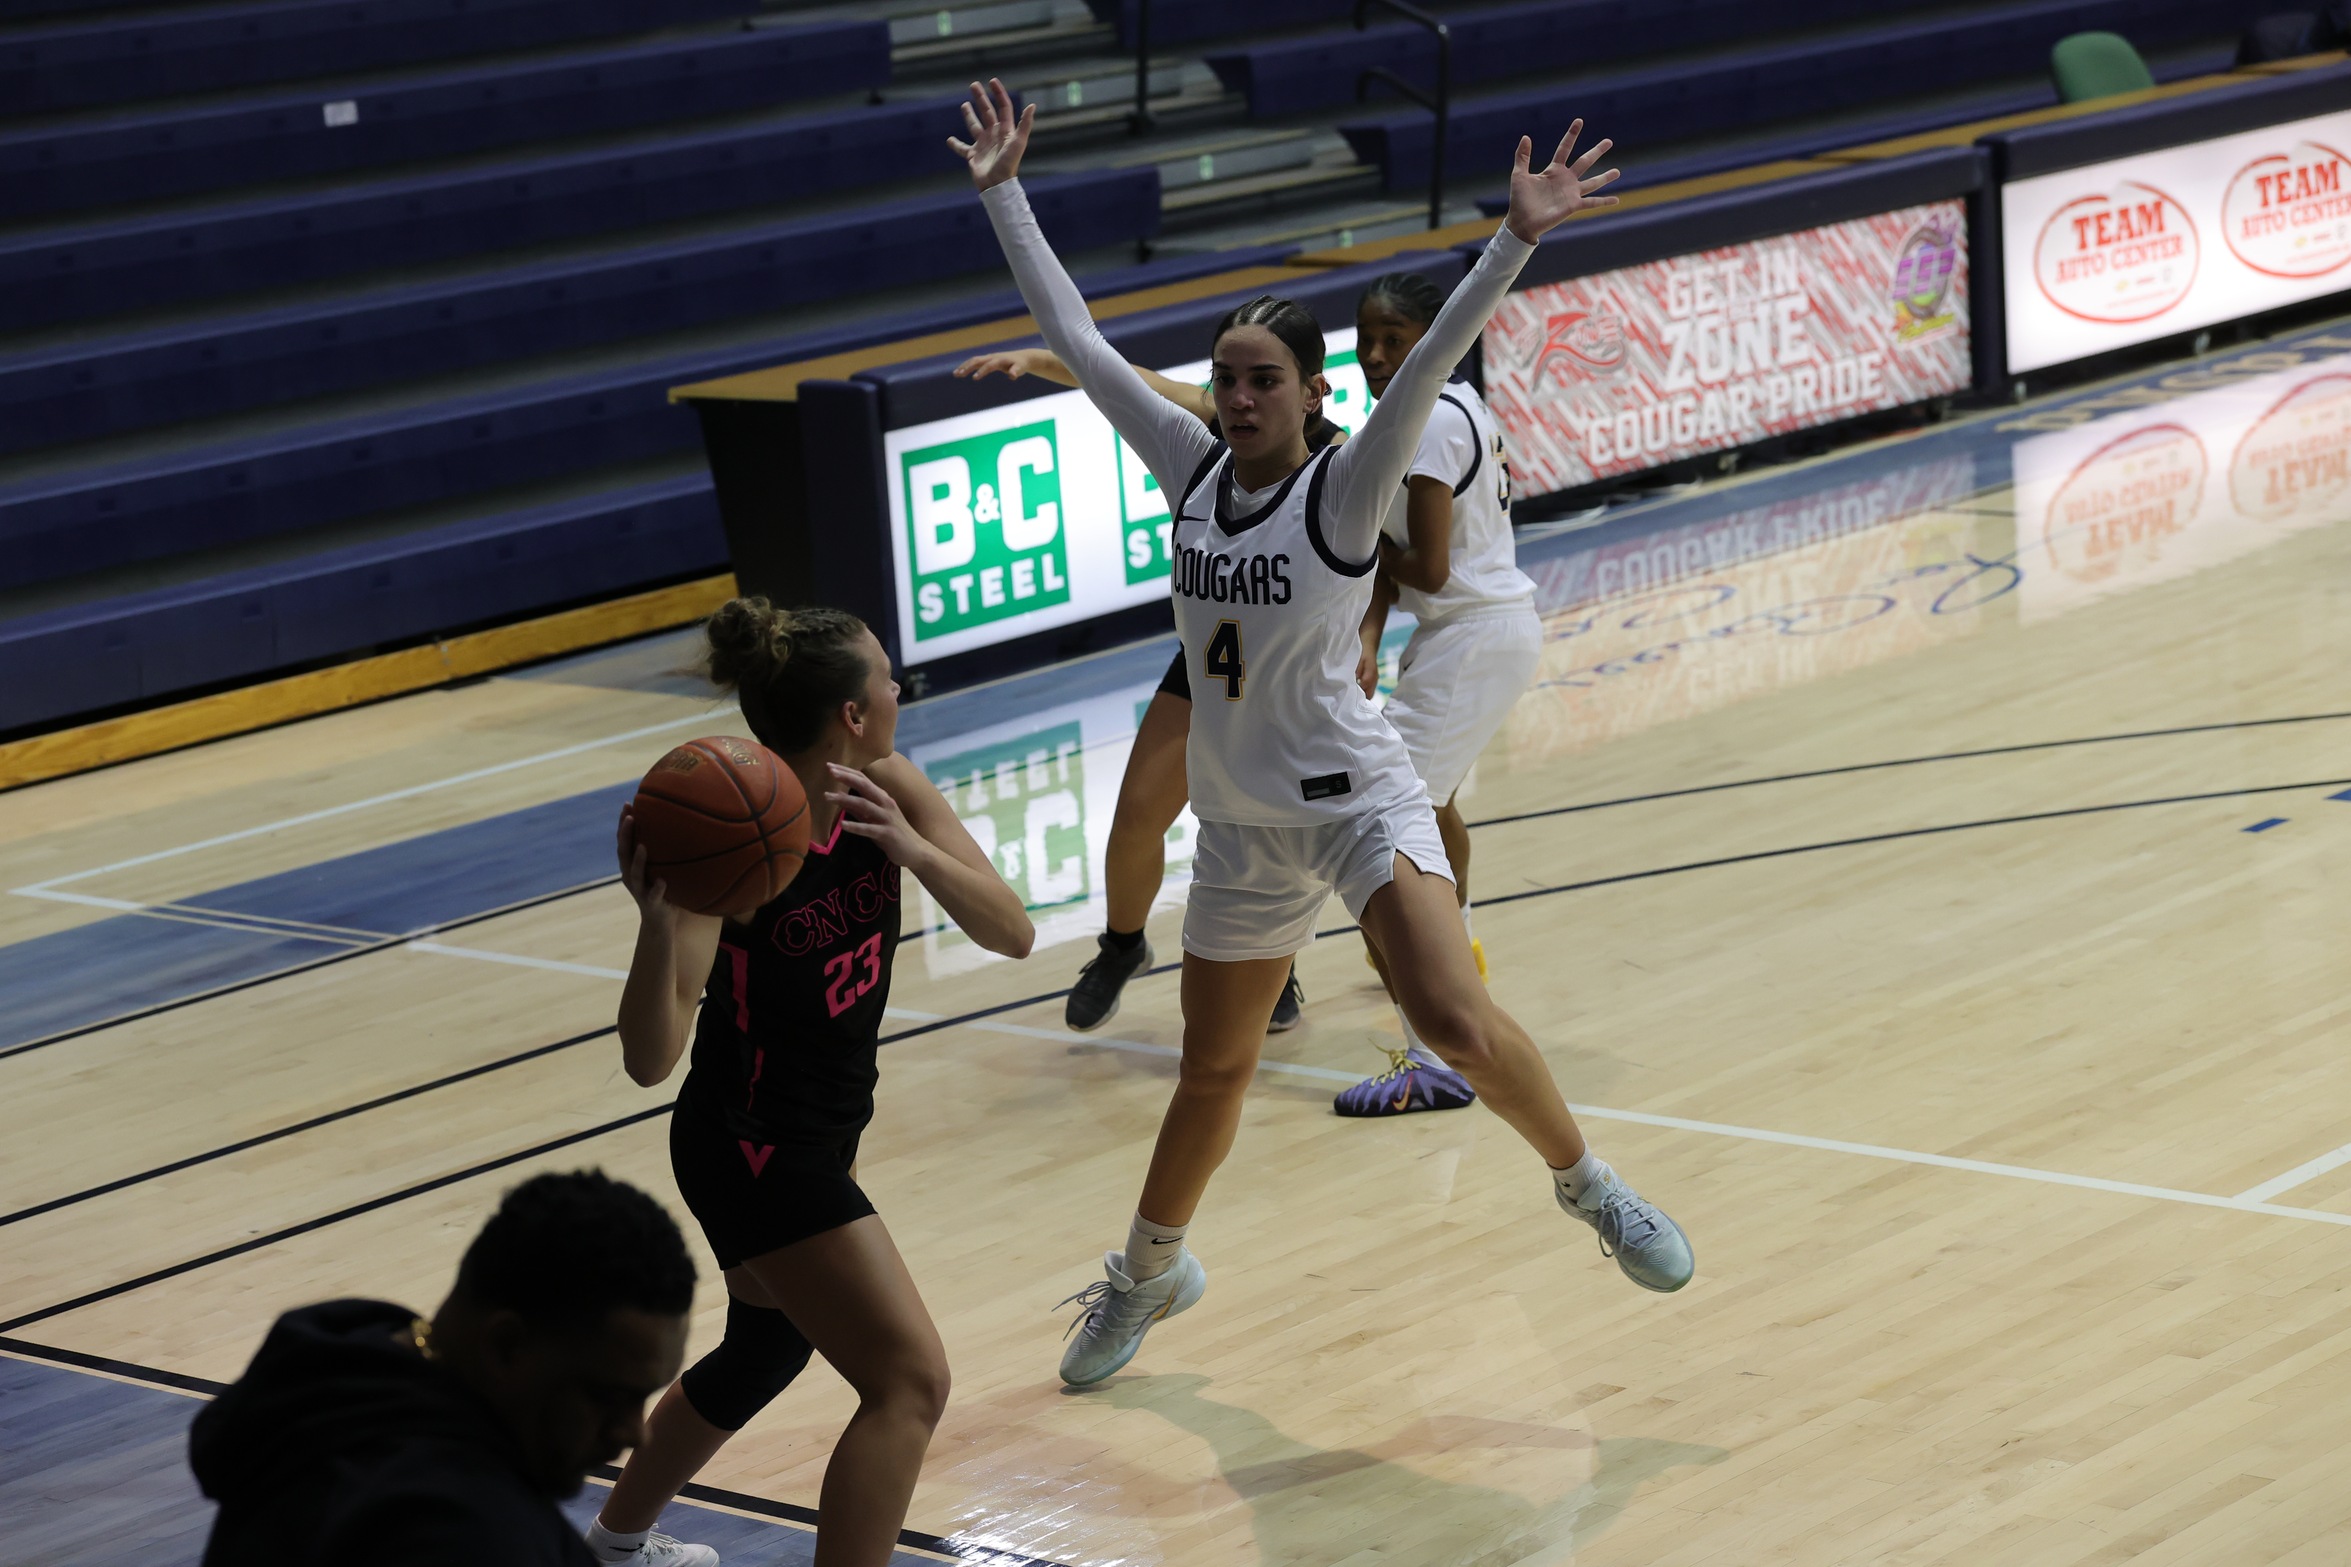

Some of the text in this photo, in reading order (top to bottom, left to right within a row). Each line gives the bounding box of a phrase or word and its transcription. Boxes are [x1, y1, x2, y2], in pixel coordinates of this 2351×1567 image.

[2241, 193, 2351, 239] AUTO CENTE
[2255, 160, 2339, 208] TEAM
[2055, 234, 2183, 284] AUTO CENTER
[2072, 200, 2165, 250] TEAM
[1668, 247, 1800, 317] GET IN
[1661, 291, 1809, 391] ZONE
[1589, 352, 1884, 466] COUGAR PRIDE
[908, 435, 1060, 576] B&C
[918, 553, 1066, 624] STEEL
[1173, 543, 1292, 605] COUGARS
[1204, 619, 1246, 701] 4
[824, 932, 882, 1018] 23
